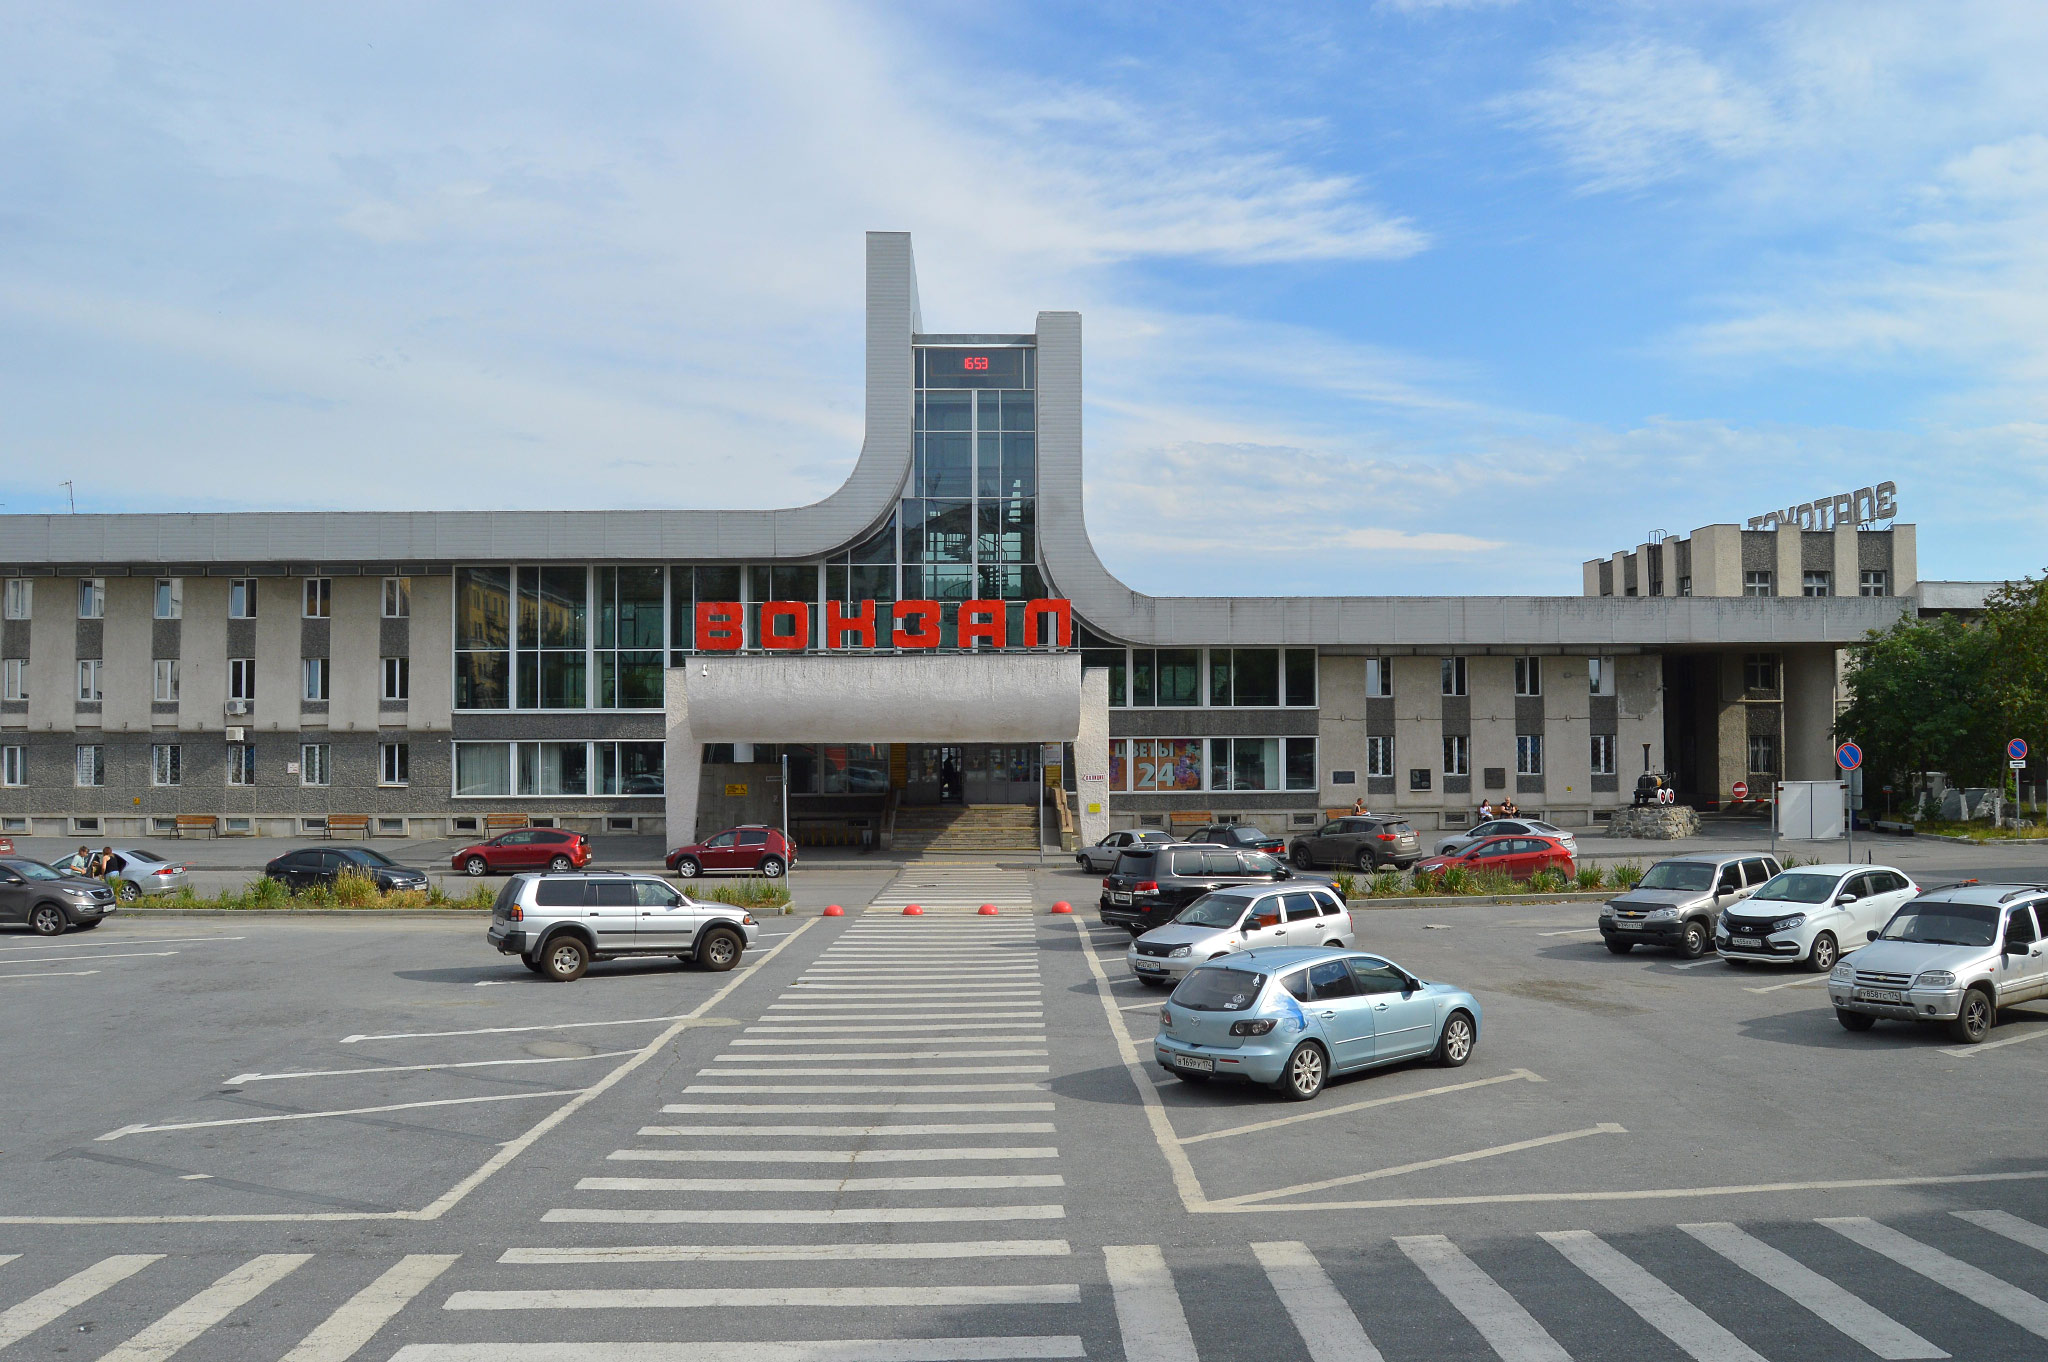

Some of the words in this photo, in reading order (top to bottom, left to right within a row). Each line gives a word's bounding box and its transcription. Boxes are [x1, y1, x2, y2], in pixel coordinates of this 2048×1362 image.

[695, 598, 1072, 650] ВОКЗАЛ
[1114, 742, 1174, 759] ЦВЕТЫ
[1138, 763, 1175, 787] 24
